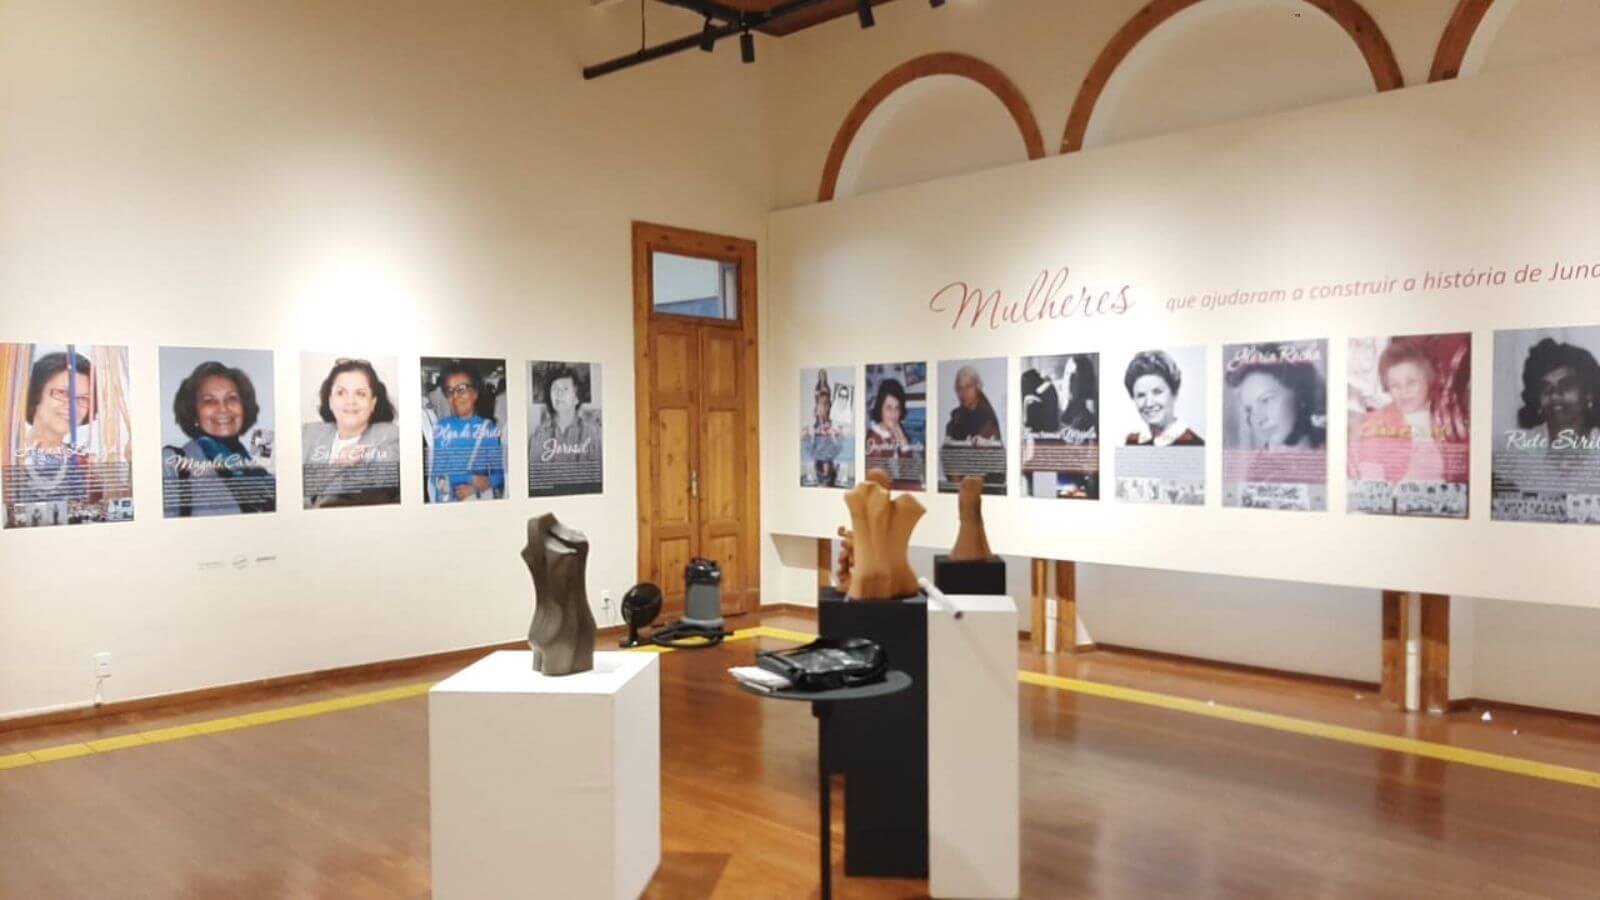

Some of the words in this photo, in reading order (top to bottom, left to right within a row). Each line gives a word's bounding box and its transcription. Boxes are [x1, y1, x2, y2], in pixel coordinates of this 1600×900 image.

[929, 266, 1134, 330] Mulheres
[1165, 296, 1197, 312] que
[1200, 289, 1287, 311] ajudaram
[1292, 287, 1304, 301] a
[1309, 275, 1398, 299] construir
[1403, 277, 1417, 292] a
[1422, 267, 1507, 289] história
[1514, 263, 1542, 284] de
[1503, 430, 1548, 451] Rute
[167, 453, 224, 478] Magali
